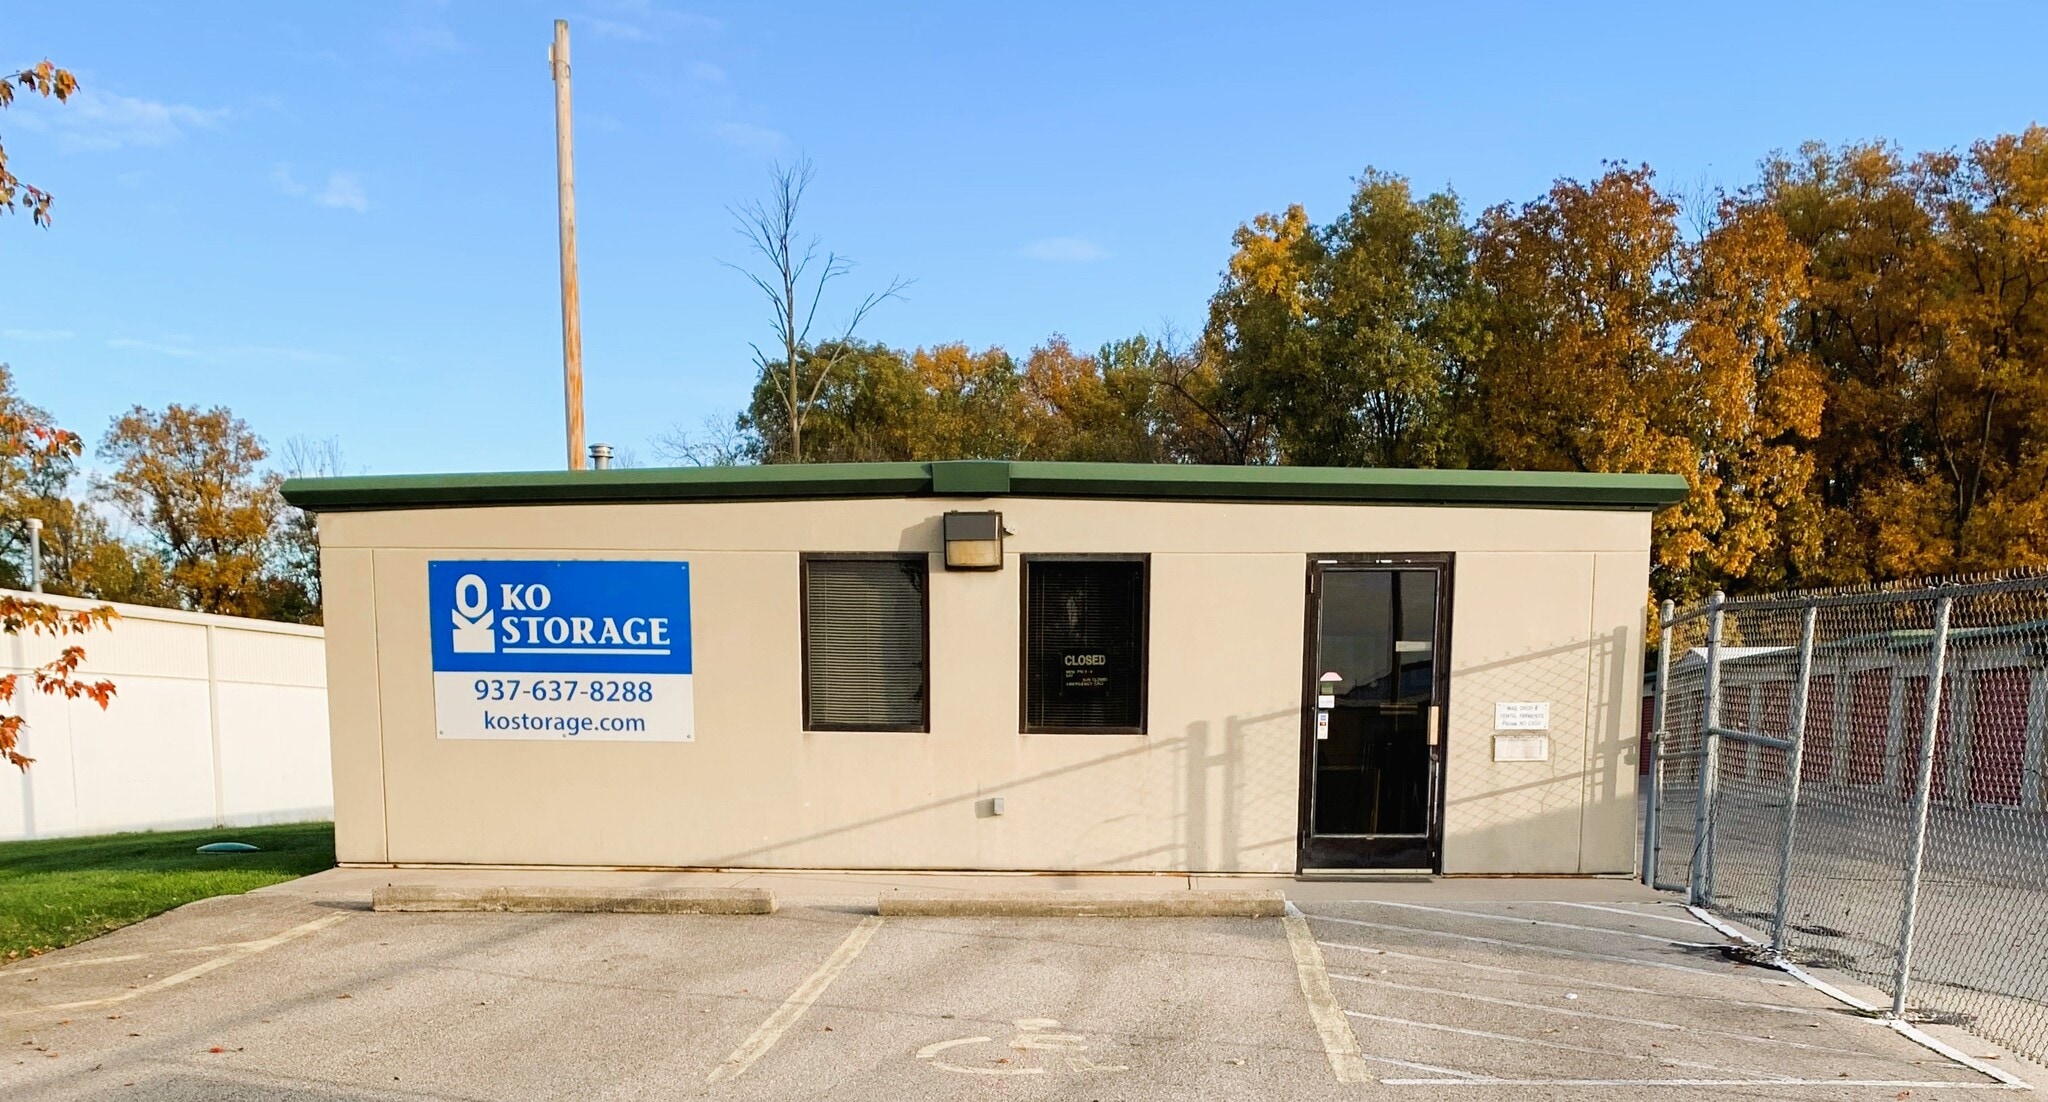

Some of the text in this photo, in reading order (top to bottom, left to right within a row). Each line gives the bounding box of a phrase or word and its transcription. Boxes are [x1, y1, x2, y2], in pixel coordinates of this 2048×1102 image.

[500, 583, 552, 611] KO
[501, 616, 671, 645] STORAGE
[1064, 655, 1106, 666] CLOSED
[474, 679, 654, 702] 937-637-8288
[484, 711, 646, 736] kostorage.com
